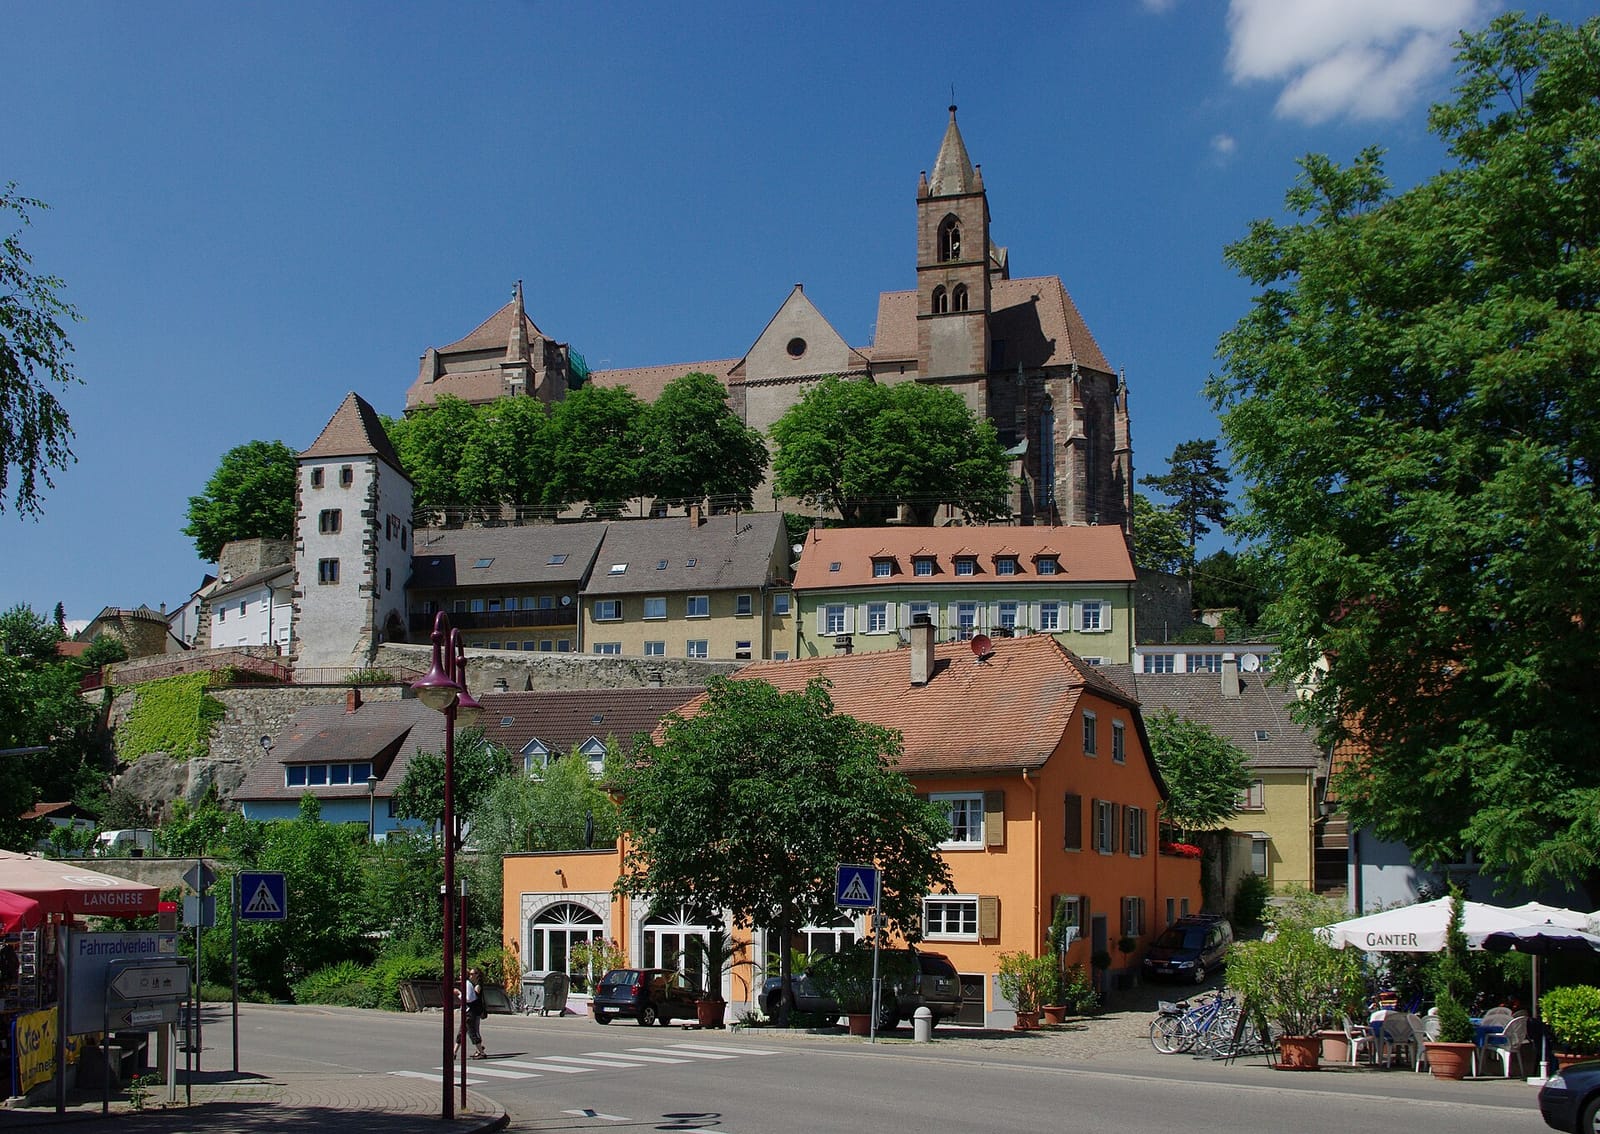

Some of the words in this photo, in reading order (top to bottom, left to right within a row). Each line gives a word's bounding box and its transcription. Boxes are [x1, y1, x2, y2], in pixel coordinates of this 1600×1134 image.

[83, 892, 143, 906] LANGNESE
[79, 937, 156, 956] Fahrradverleih
[1366, 932, 1418, 947] GANTER
